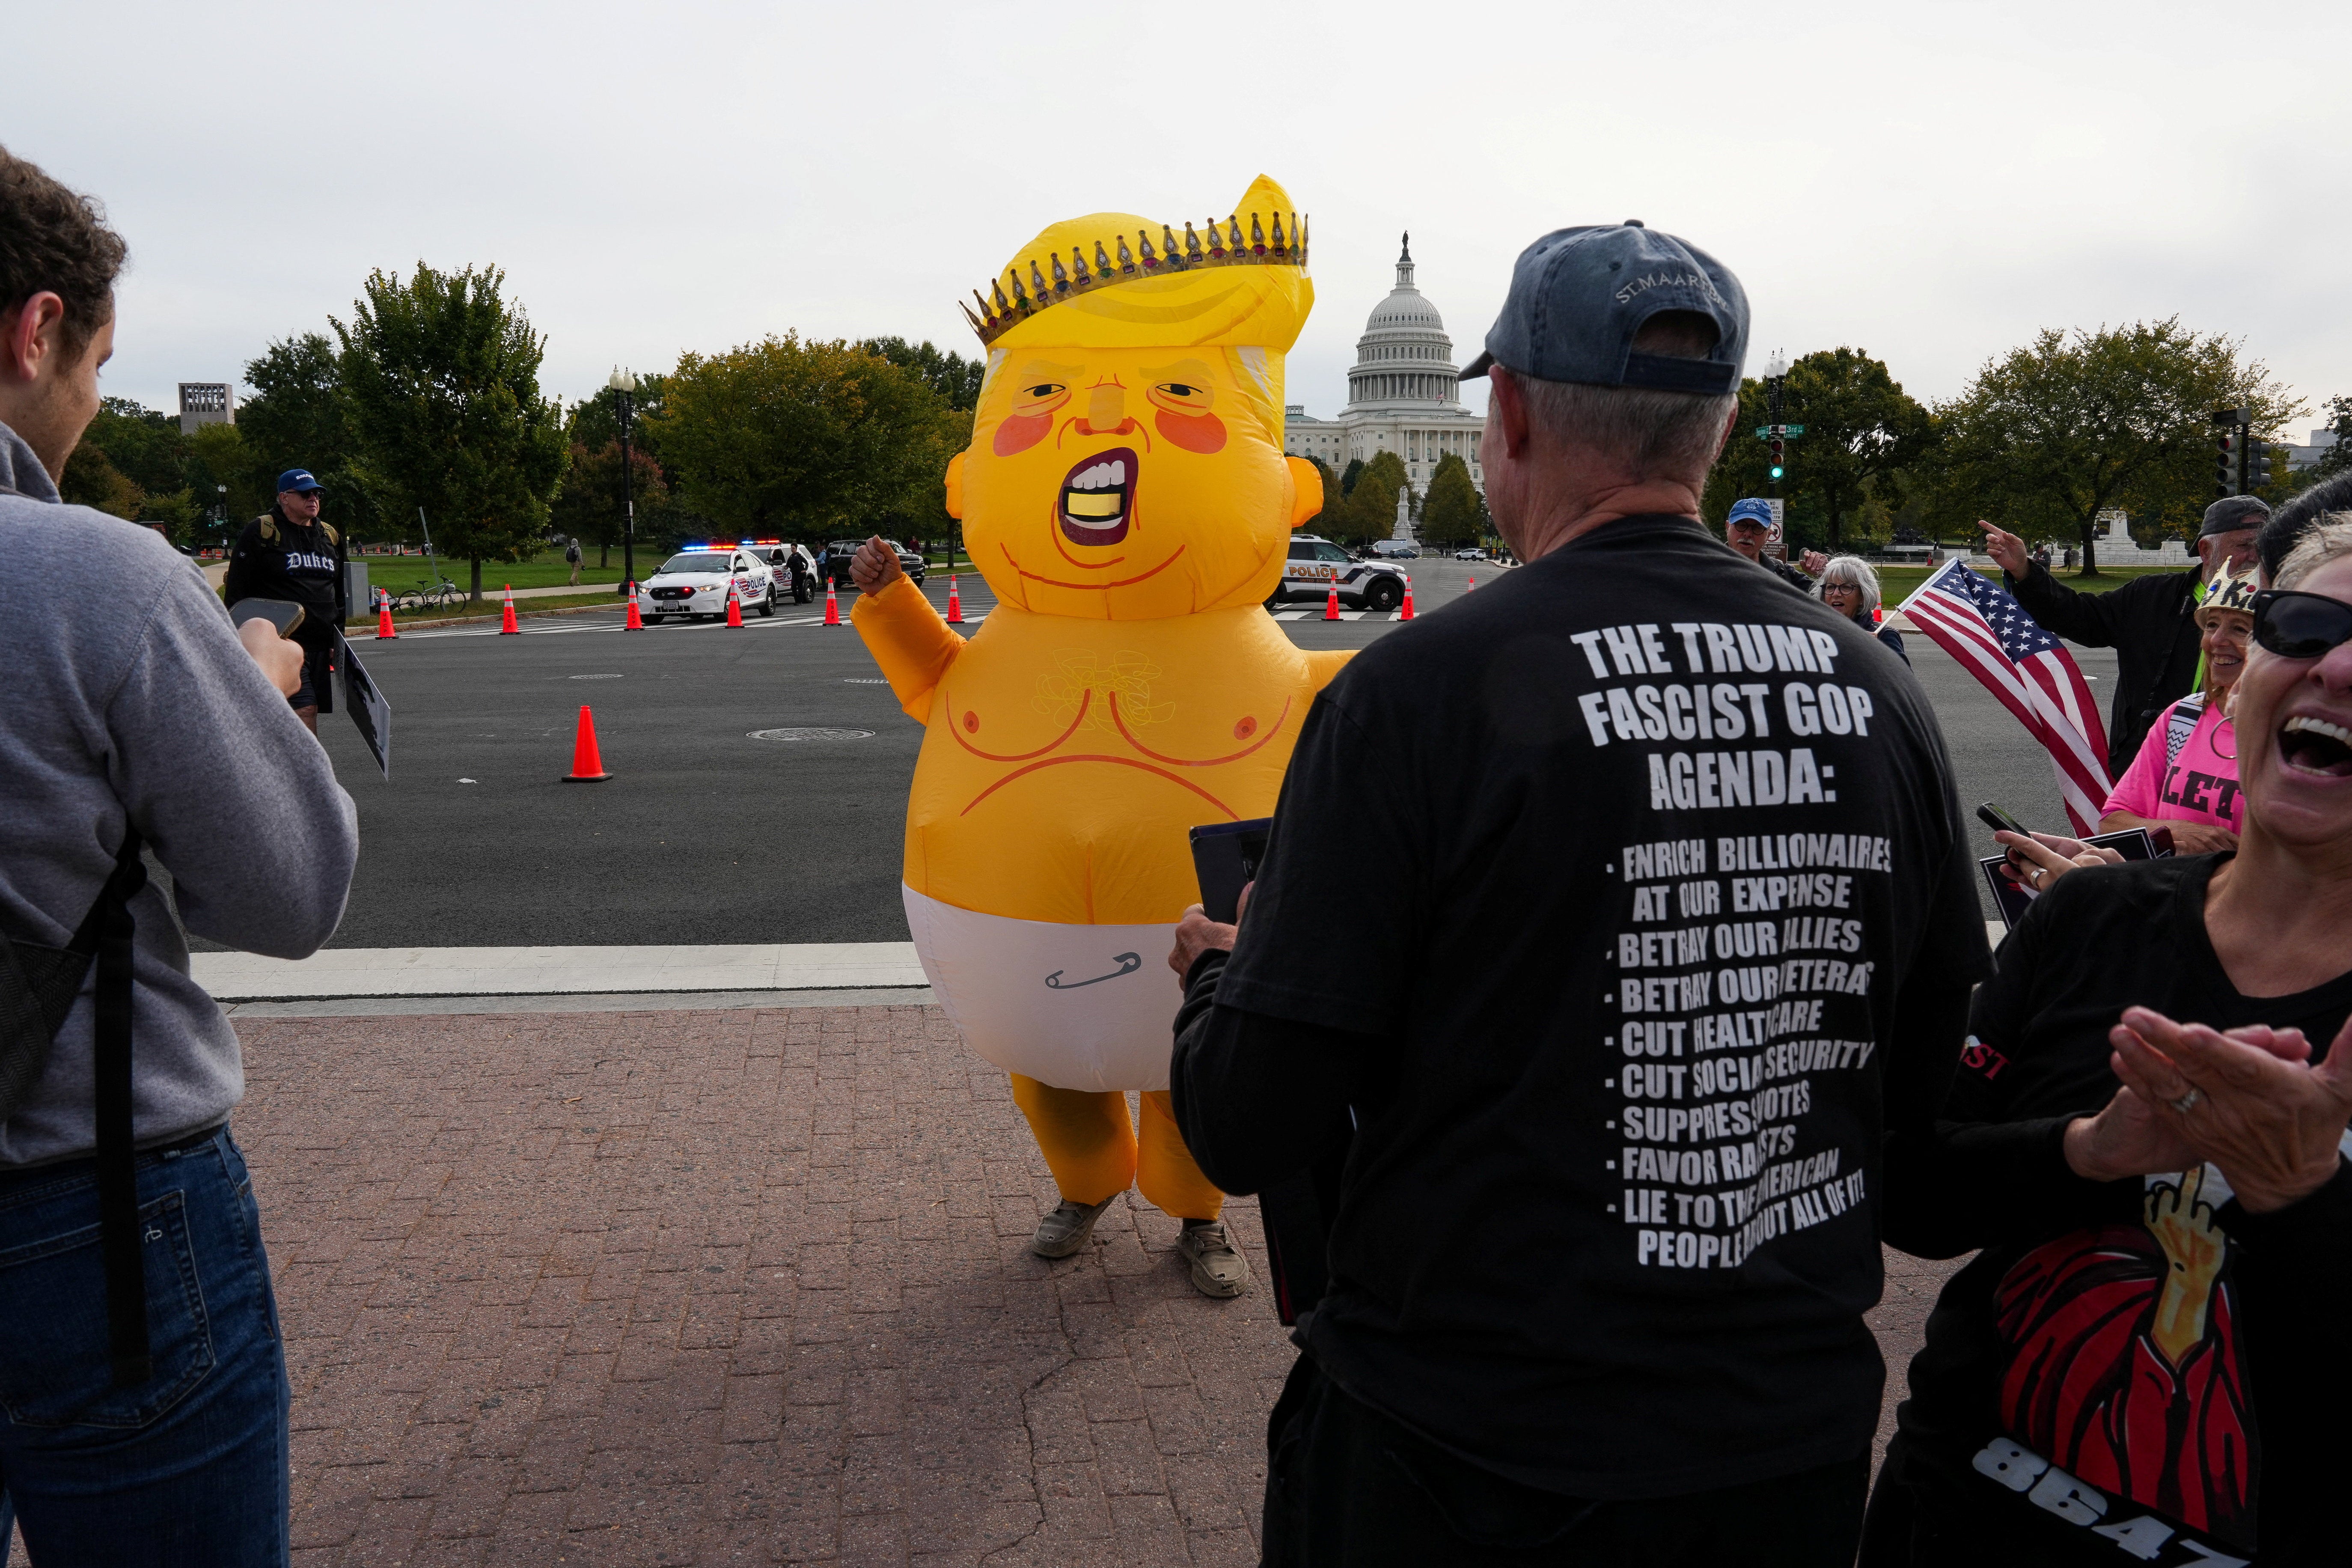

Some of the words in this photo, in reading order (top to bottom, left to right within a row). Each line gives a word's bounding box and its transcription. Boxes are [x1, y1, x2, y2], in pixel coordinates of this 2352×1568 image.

[286, 551, 335, 572] Dukes
[747, 577, 766, 590] POLICE
[1288, 566, 1338, 578] POLICE
[1570, 623, 1672, 678] THE
[1673, 622, 1839, 675] TRUMP
[1577, 684, 1770, 747] FASCIST
[1784, 682, 1873, 737] GOP
[1648, 748, 1837, 810] AGENDA:
[1622, 839, 1707, 883] ENRICH
[1717, 833, 1892, 873] BILLIONAIRES
[1632, 885, 1671, 922] AT
[1679, 881, 1720, 918] OUR
[1732, 873, 1852, 913] EXPENSE
[1618, 926, 1709, 968] BETRAY
[1714, 920, 1778, 959] OUR
[1782, 916, 1862, 954] ALLIES
[1621, 972, 1711, 1013] BETRAY
[1718, 966, 1779, 1004] OUR
[1621, 1021, 1687, 1057] CUT
[1694, 1000, 1823, 1053] HEALTCARE
[1621, 1064, 1687, 1099] CUT
[1693, 1055, 1764, 1098] SOCIA
[1765, 1039, 1876, 1080] SECURITY
[1753, 1079, 1810, 1125] VOTES
[1623, 1147, 1717, 1186] FAVOR
[1624, 1189, 1667, 1224] LIE
[1673, 1194, 1716, 1229] TO
[1718, 1184, 1757, 1227] THE
[1637, 1229, 1743, 1269] PEOPLE
[1790, 1189, 1829, 1231] ALL
[1824, 1179, 1847, 1217] OF
[1846, 1167, 1865, 1207] IT!
